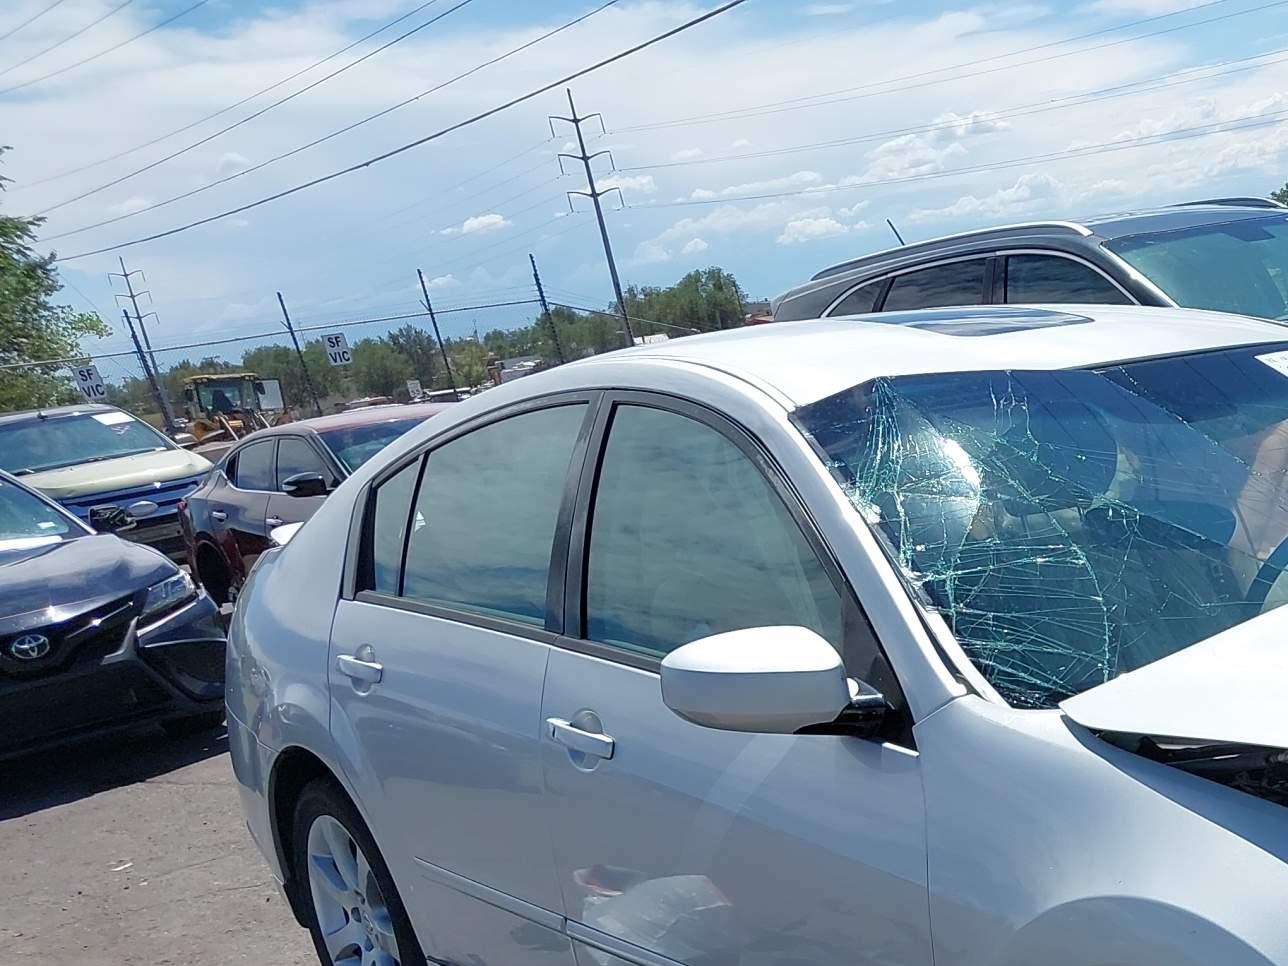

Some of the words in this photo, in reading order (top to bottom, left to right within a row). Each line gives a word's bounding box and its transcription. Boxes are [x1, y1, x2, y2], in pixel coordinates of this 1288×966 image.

[327, 335, 342, 348] SF
[328, 350, 350, 363] VIC
[78, 368, 94, 382] SF
[81, 383, 105, 398] VIC
